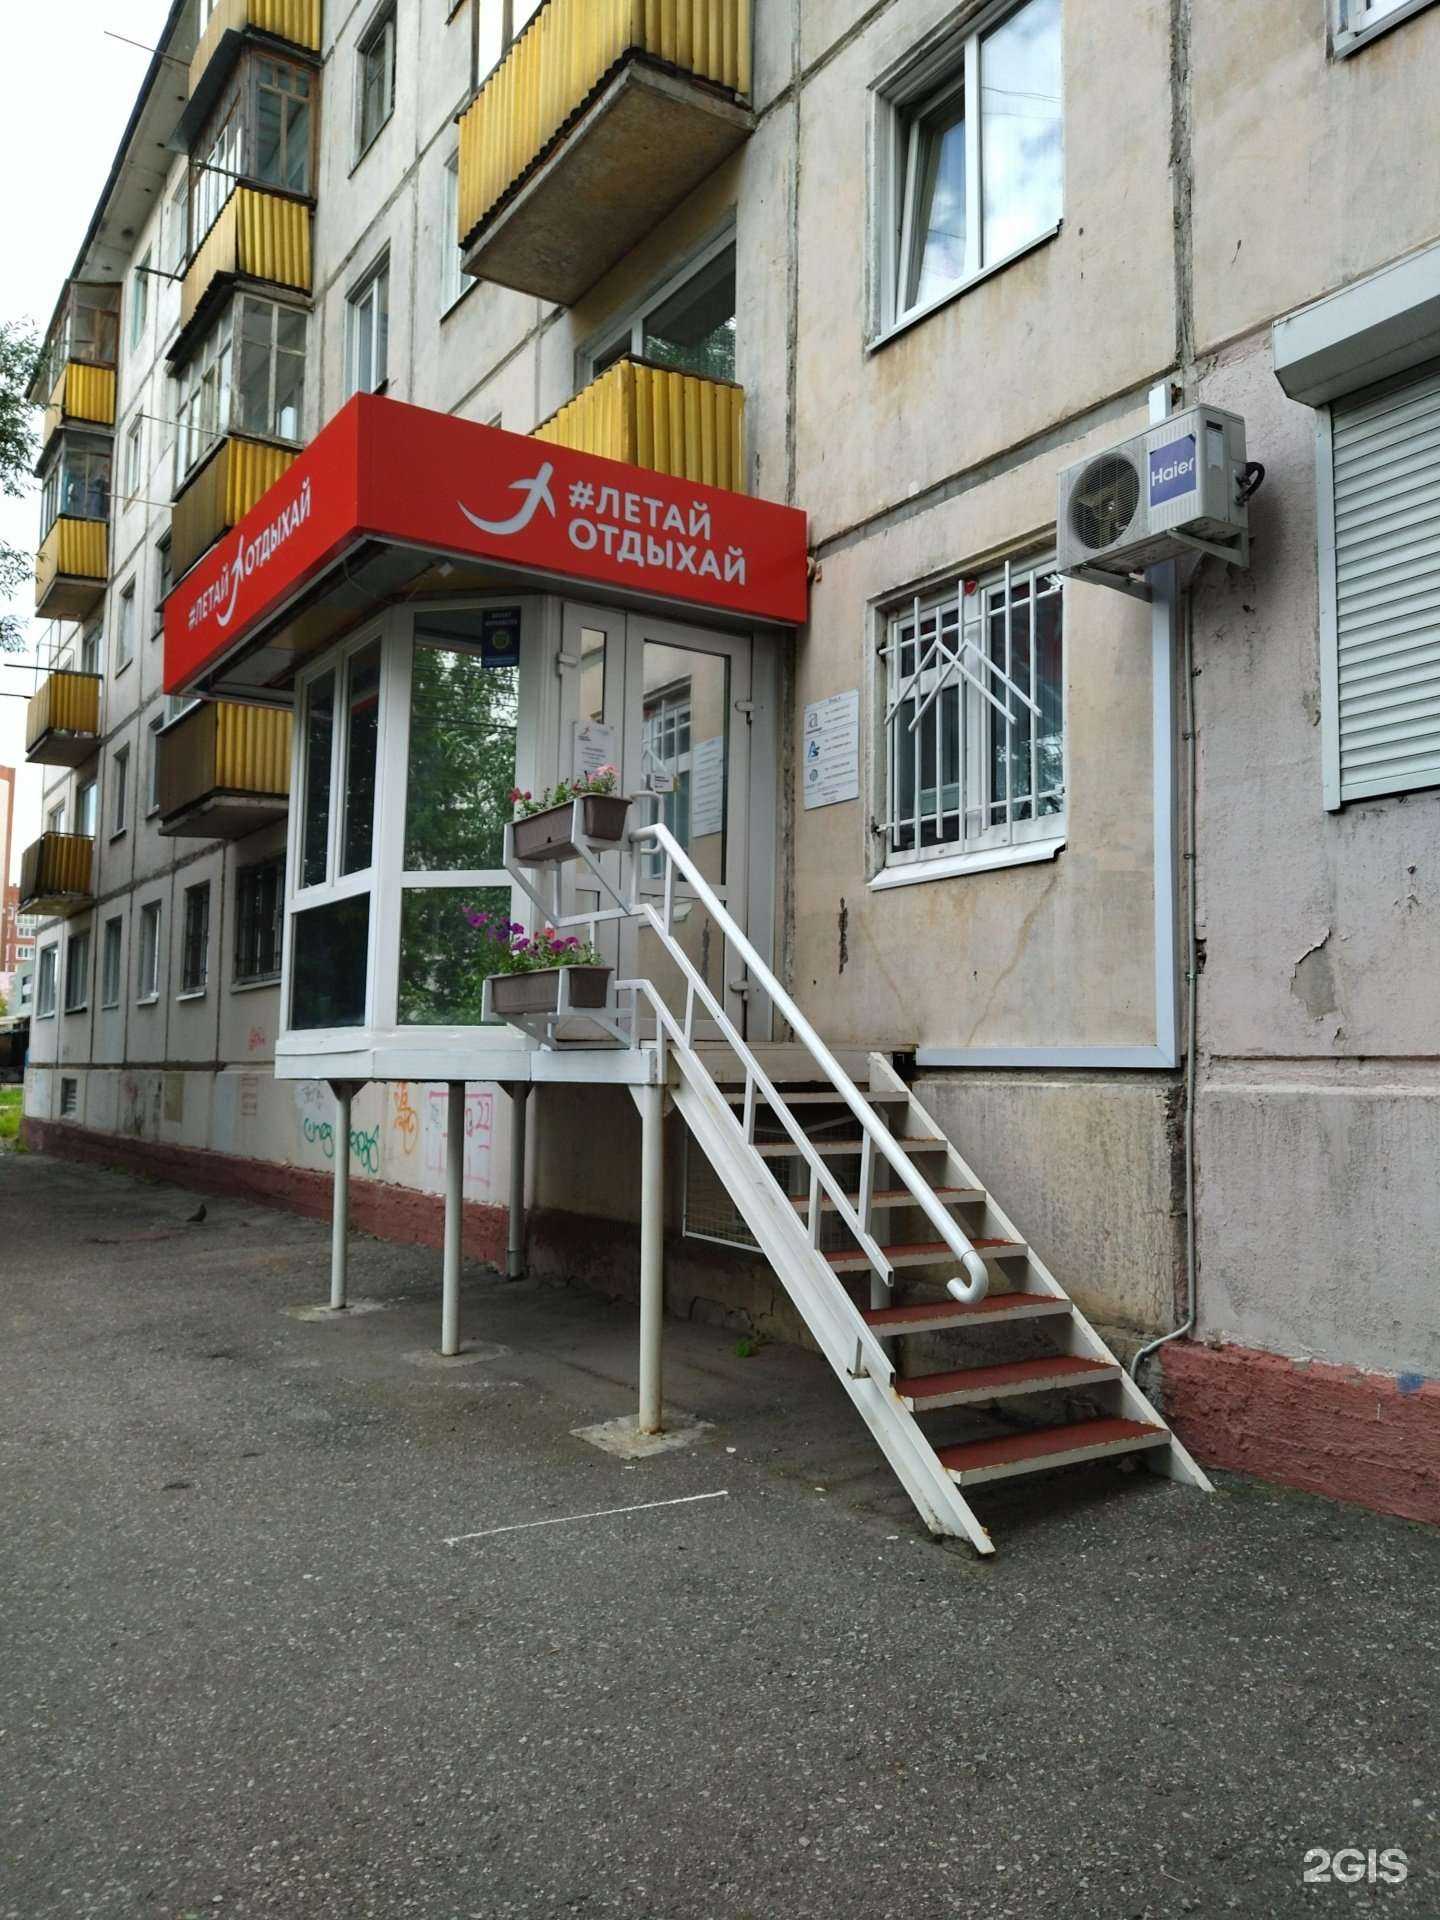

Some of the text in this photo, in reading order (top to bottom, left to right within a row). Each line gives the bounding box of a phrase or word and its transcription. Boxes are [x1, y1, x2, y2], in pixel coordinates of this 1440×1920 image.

[1151, 457, 1194, 487] Haier
[568, 480, 712, 541] #ЛЕТАЙ
[188, 476, 311, 632] #ЛЕТАЙ ОТДЫХАЙ
[568, 518, 746, 586] ОТДЫХАЙ
